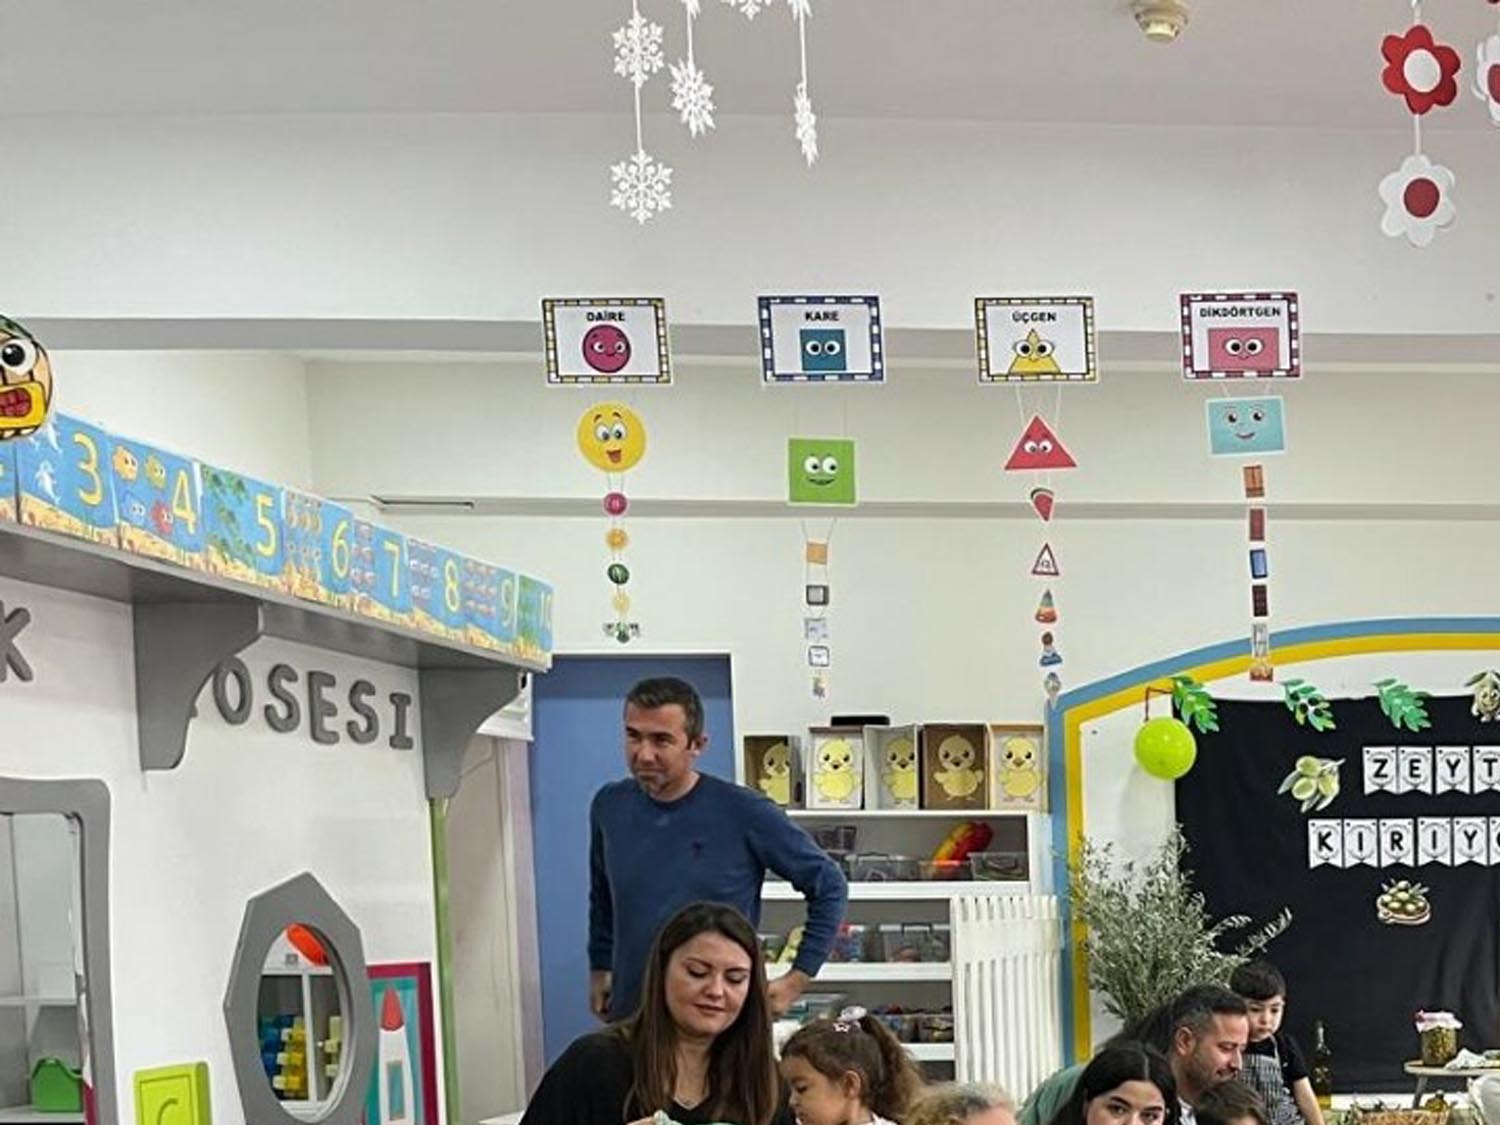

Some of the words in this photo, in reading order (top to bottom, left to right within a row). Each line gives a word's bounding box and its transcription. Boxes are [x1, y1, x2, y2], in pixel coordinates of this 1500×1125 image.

[805, 310, 839, 321] KARE
[1012, 310, 1057, 324] ÜÇGEN
[1200, 305, 1280, 317] DİKDÖRTGEN
[74, 432, 102, 505] 3
[171, 469, 196, 535] 4
[256, 493, 276, 556] 5
[332, 520, 350, 579] 6
[384, 540, 399, 598] 7
[444, 558, 460, 613] 8
[501, 578, 514, 626] 9
